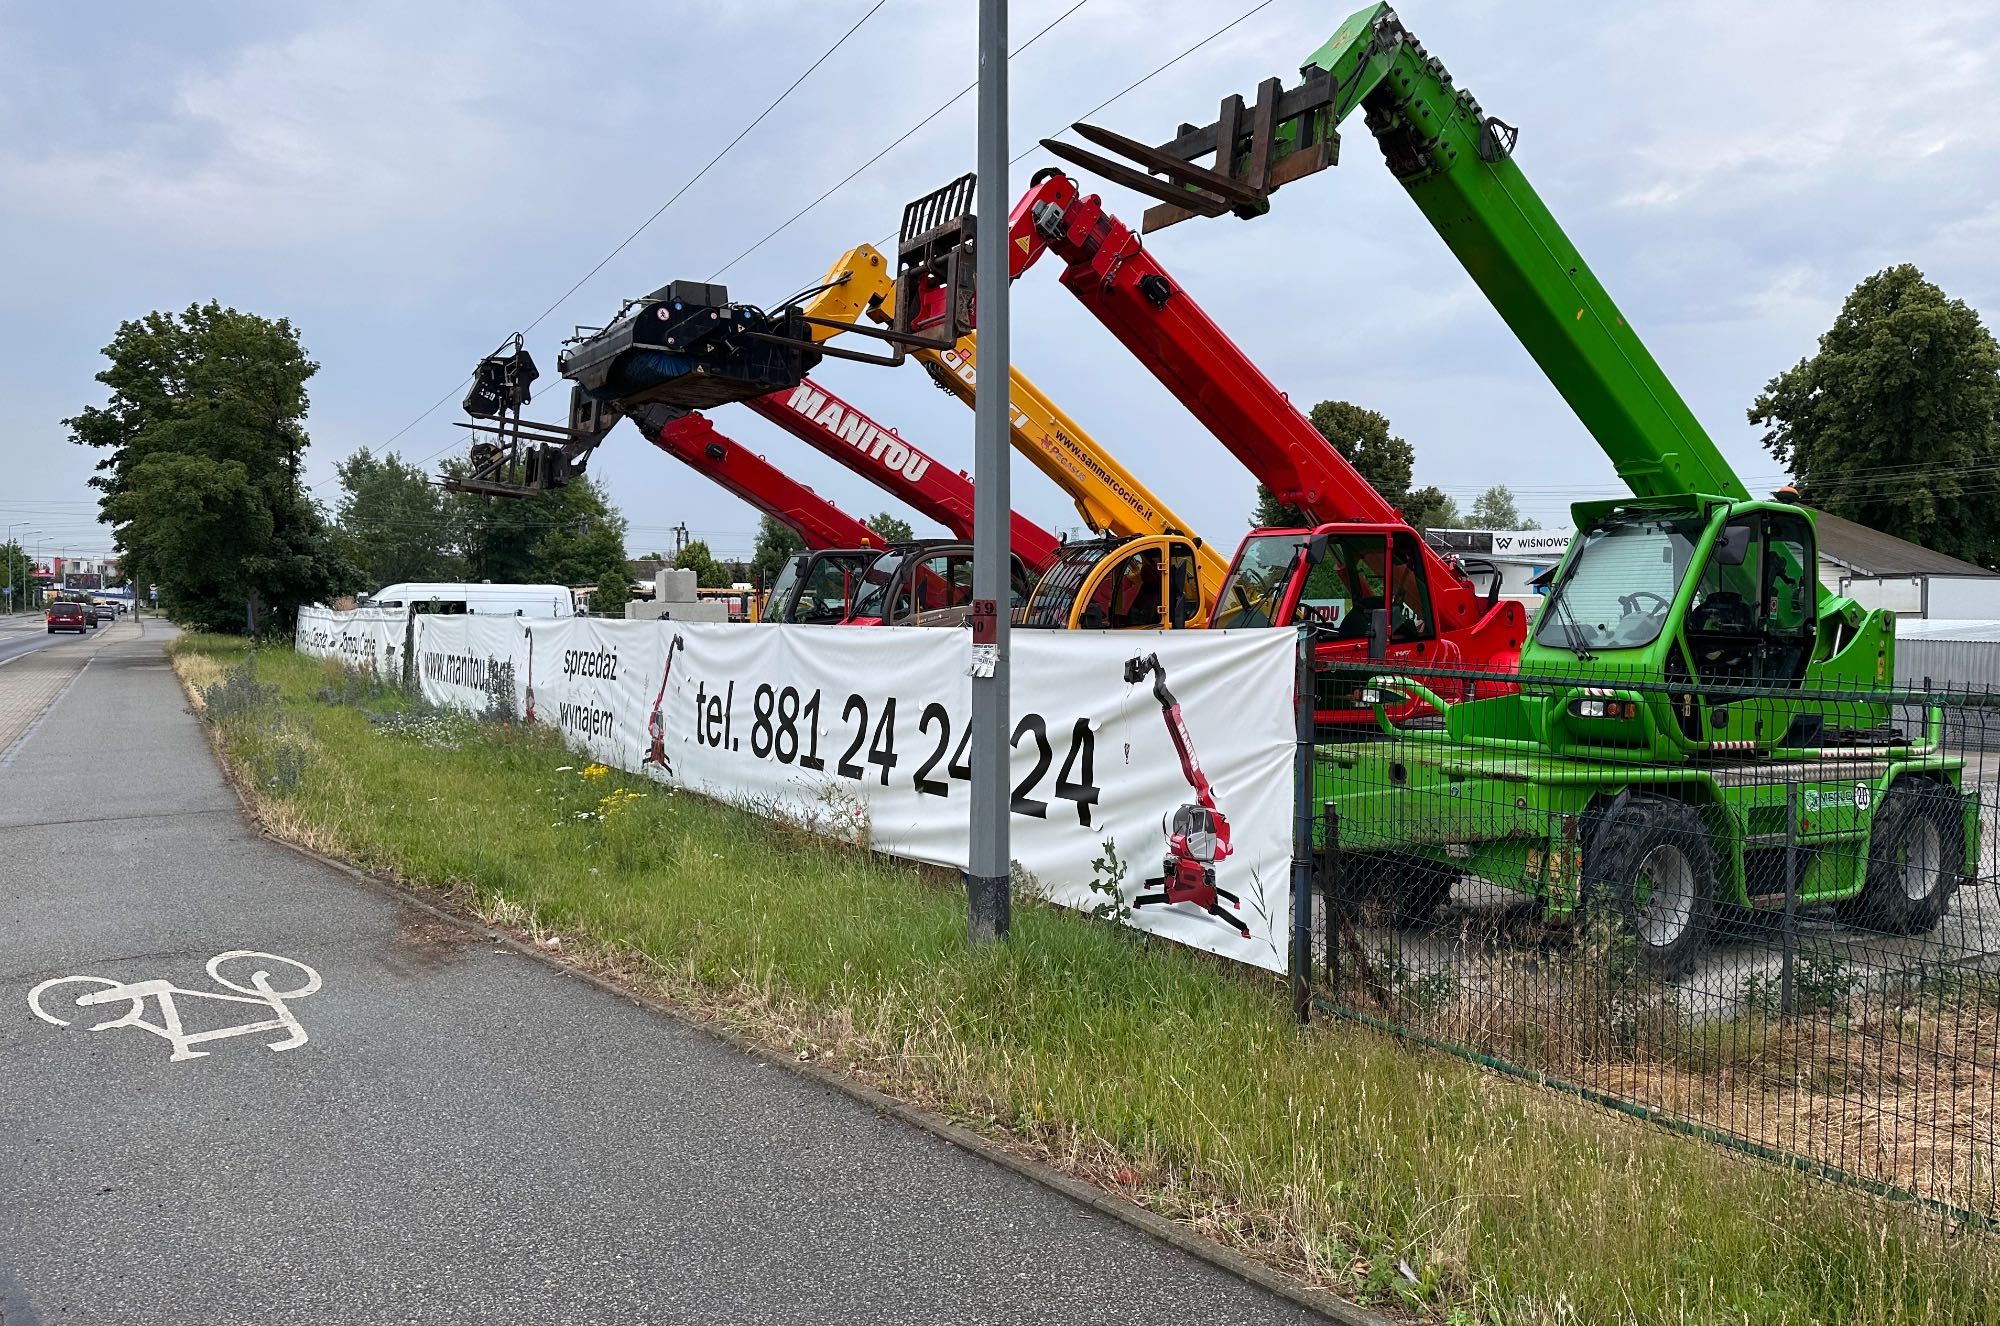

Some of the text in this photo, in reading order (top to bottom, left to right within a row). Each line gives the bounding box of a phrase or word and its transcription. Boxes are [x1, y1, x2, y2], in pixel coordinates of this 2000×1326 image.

[786, 382, 931, 482] MANITOU
[1056, 430, 1153, 521] www.sanmarcocirie.it
[564, 645, 617, 682] sprzedaż
[560, 700, 613, 741] wynajem
[696, 681, 1101, 828] tel. 881 24 24 24
